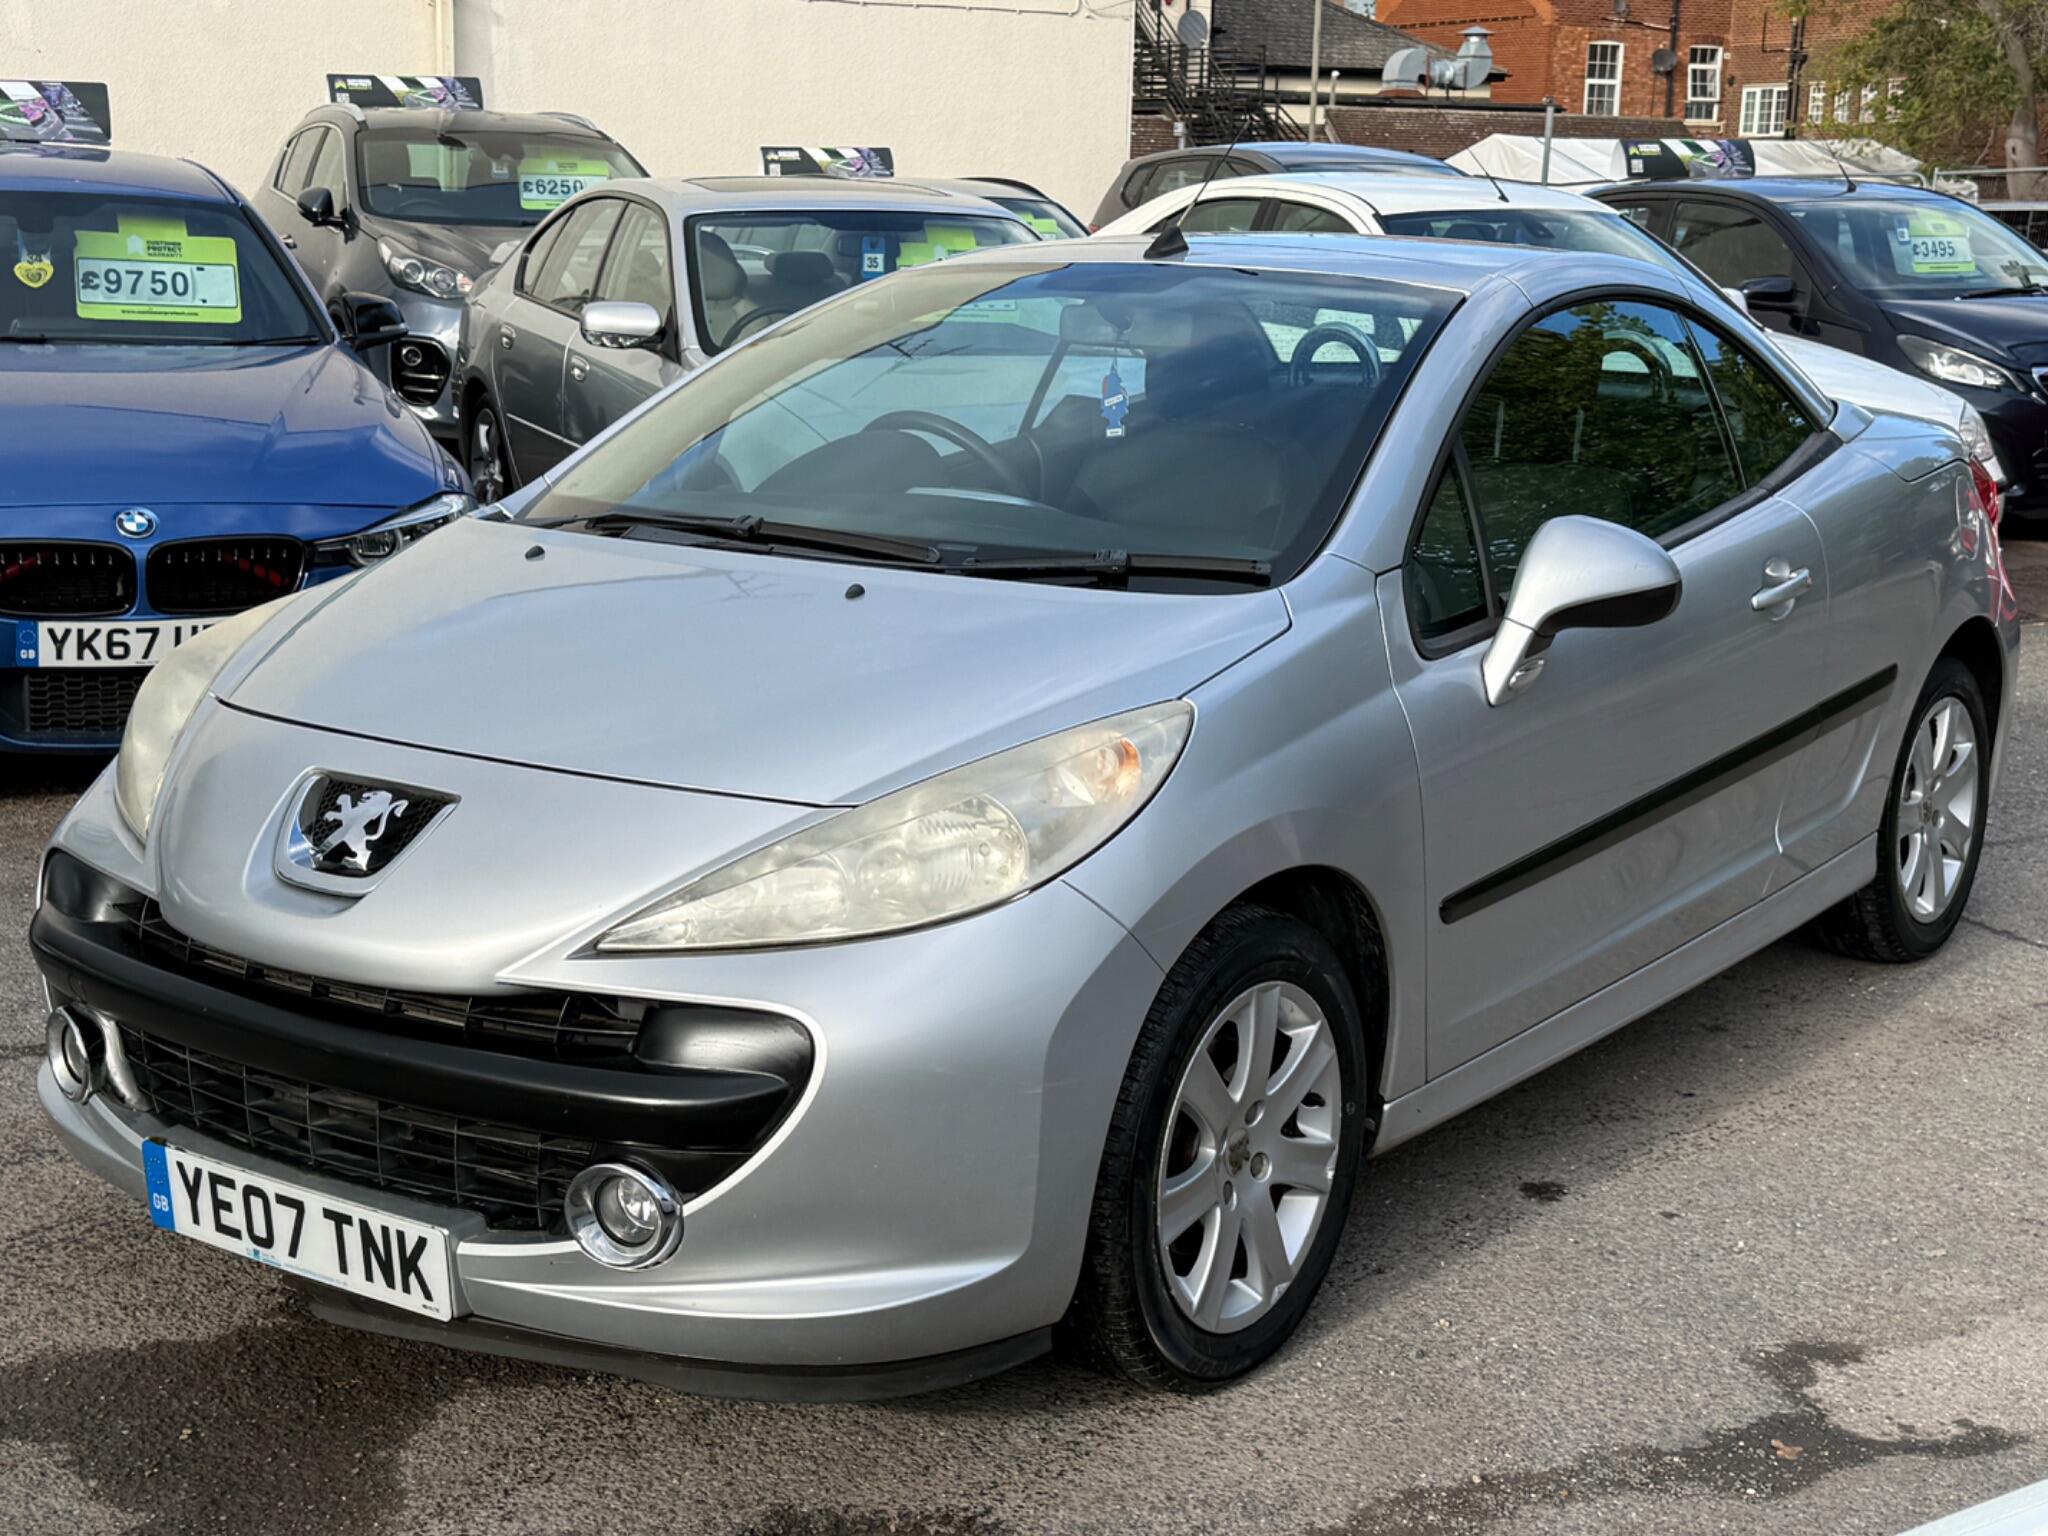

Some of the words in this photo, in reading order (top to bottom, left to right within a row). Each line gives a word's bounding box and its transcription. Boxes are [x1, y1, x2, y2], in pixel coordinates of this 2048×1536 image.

[522, 179, 584, 195] £6250
[1912, 241, 1955, 257] £3495
[866, 257, 879, 269] 35
[81, 268, 189, 297] £9750
[47, 627, 160, 661] YK67
[20, 648, 36, 660] GB
[153, 1192, 169, 1212] GB
[175, 1160, 305, 1259] YE07
[322, 1206, 434, 1302] TNK
